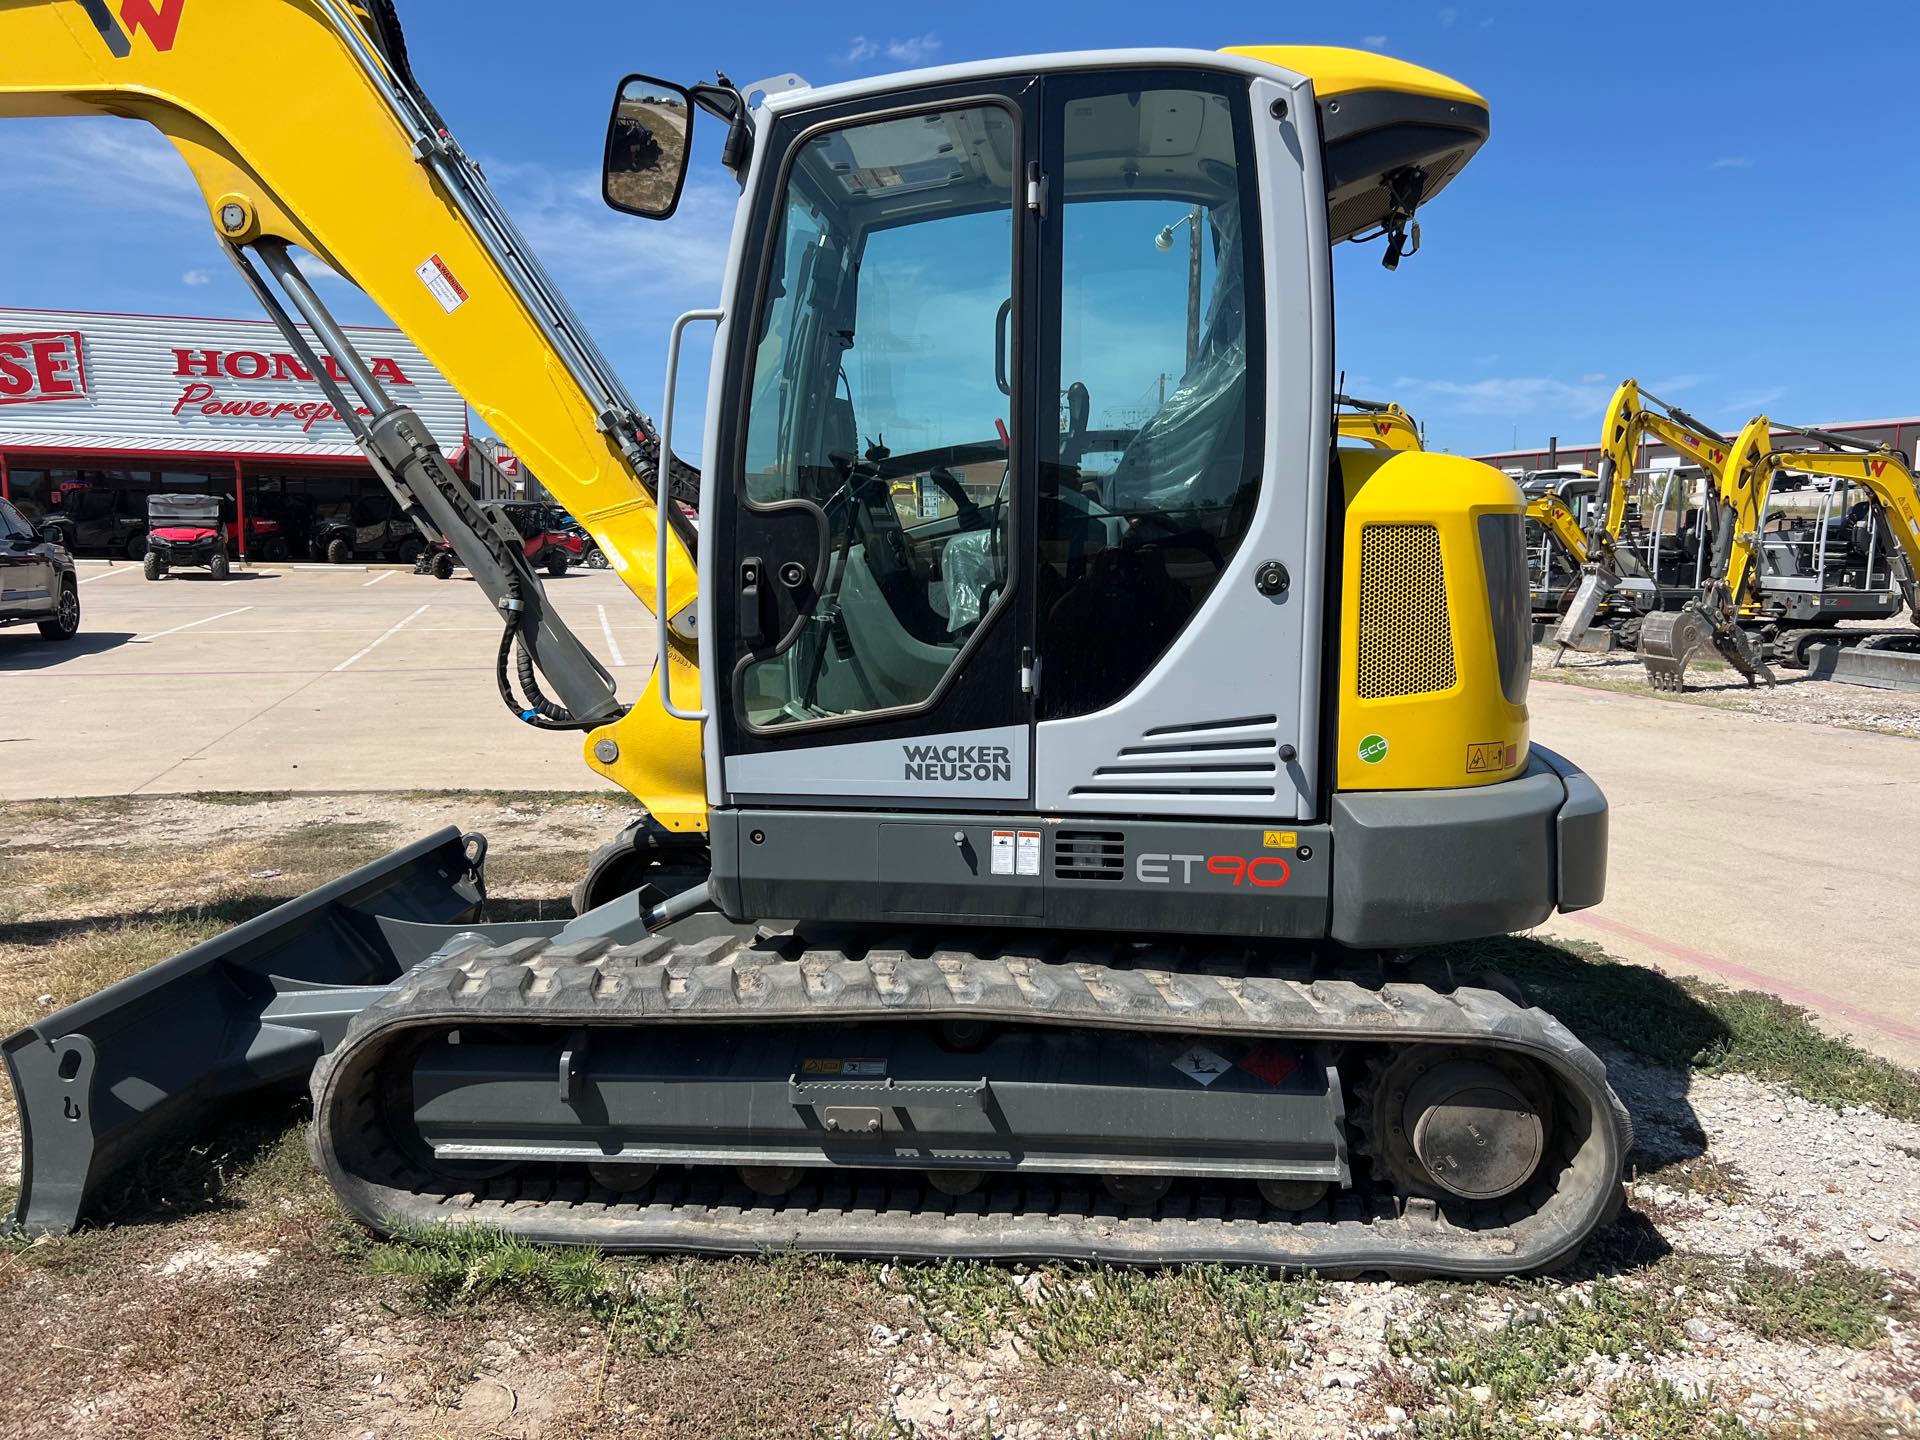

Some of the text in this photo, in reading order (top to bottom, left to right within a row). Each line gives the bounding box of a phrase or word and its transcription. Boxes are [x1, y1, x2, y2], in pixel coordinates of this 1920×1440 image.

[440, 265, 465, 295] WARNING
[902, 745, 1011, 764] WACKER
[1359, 740, 1388, 759] ECO
[904, 763, 1011, 782] NEUSON
[1136, 853, 1291, 888] ET90
